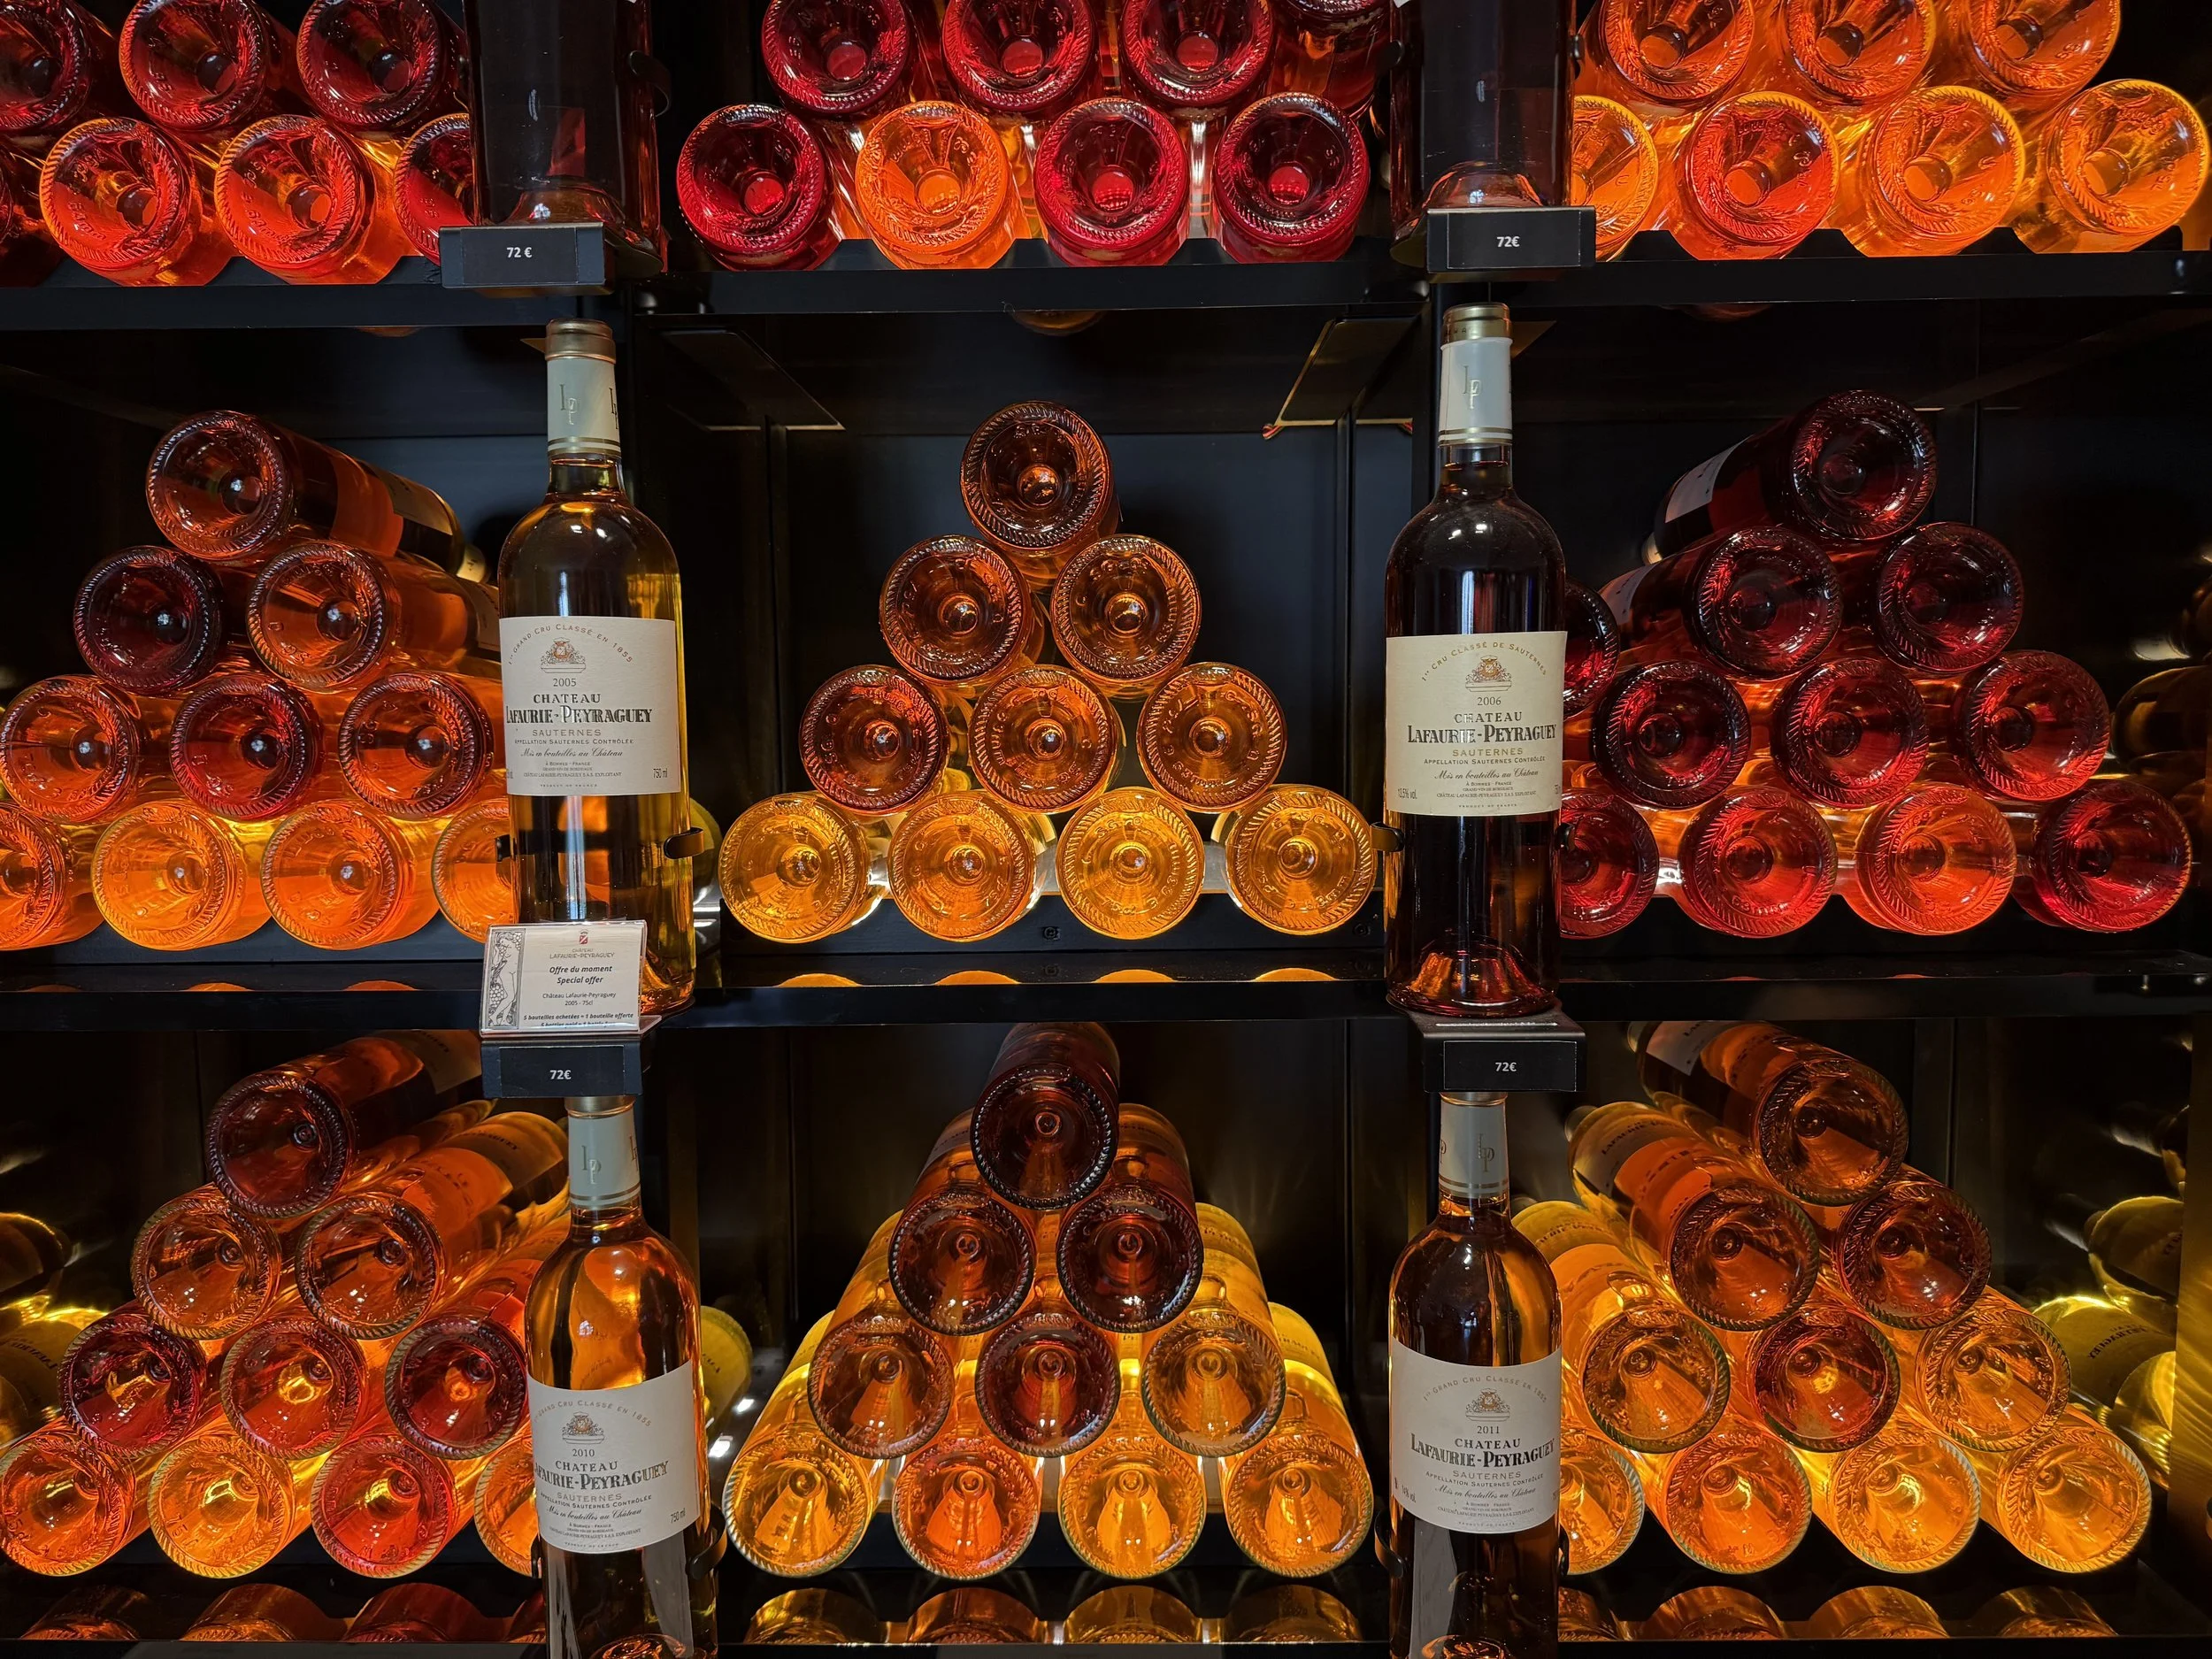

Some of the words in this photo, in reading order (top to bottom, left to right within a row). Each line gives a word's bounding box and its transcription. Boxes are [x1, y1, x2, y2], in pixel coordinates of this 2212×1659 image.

[1497, 235, 1520, 248] 72€
[513, 634, 532, 653] GRAND
[534, 625, 550, 635] CRU
[556, 623, 593, 635] CLASSÉ
[596, 634, 609, 642] EN
[612, 642, 634, 663] 1855
[1432, 657, 1448, 670] CRU
[1451, 641, 1486, 657] CLASSÉ
[1509, 642, 1547, 676] SAUTERNES
[553, 678, 577, 687] 2005
[533, 694, 602, 704] CHATEAU
[1478, 696, 1502, 706] 2006
[1454, 711, 1523, 724] CHATEAU
[520, 749, 534, 757] Mis
[543, 748, 577, 757] bouteilles
[591, 748, 623, 757] Château
[1453, 748, 1524, 757] SAUTERNES
[653, 768, 662, 779] 750
[1434, 770, 1453, 779] Mis
[1465, 770, 1500, 780] bouteilles
[1513, 768, 1539, 778] Château
[585, 976, 603, 985] offer
[1495, 1062, 1517, 1071] 72€
[549, 1070, 572, 1079] 72€
[1433, 1381, 1458, 1394] GRAND
[632, 1410, 652, 1427] 1855
[1477, 1425, 1500, 1434] 2011
[1455, 1438, 1521, 1449] CHATEAU
[572, 1448, 595, 1457] 2010
[556, 1460, 618, 1472] CHATEAU
[534, 1460, 669, 1490] AFAURIE-PEYRAGUEY
[1425, 1471, 1469, 1486] APPELLATION
[1453, 1470, 1522, 1480] SAUTERNES
[557, 1493, 622, 1502] SAUTERNES
[1434, 1484, 1453, 1495] Mis
[1464, 1489, 1498, 1500] bouteilles
[1510, 1487, 1536, 1499] Château
[546, 1506, 559, 1516] Mis
[568, 1511, 598, 1520] bouteilles
[611, 1509, 642, 1518] Château
[670, 1511, 680, 1524] 750
